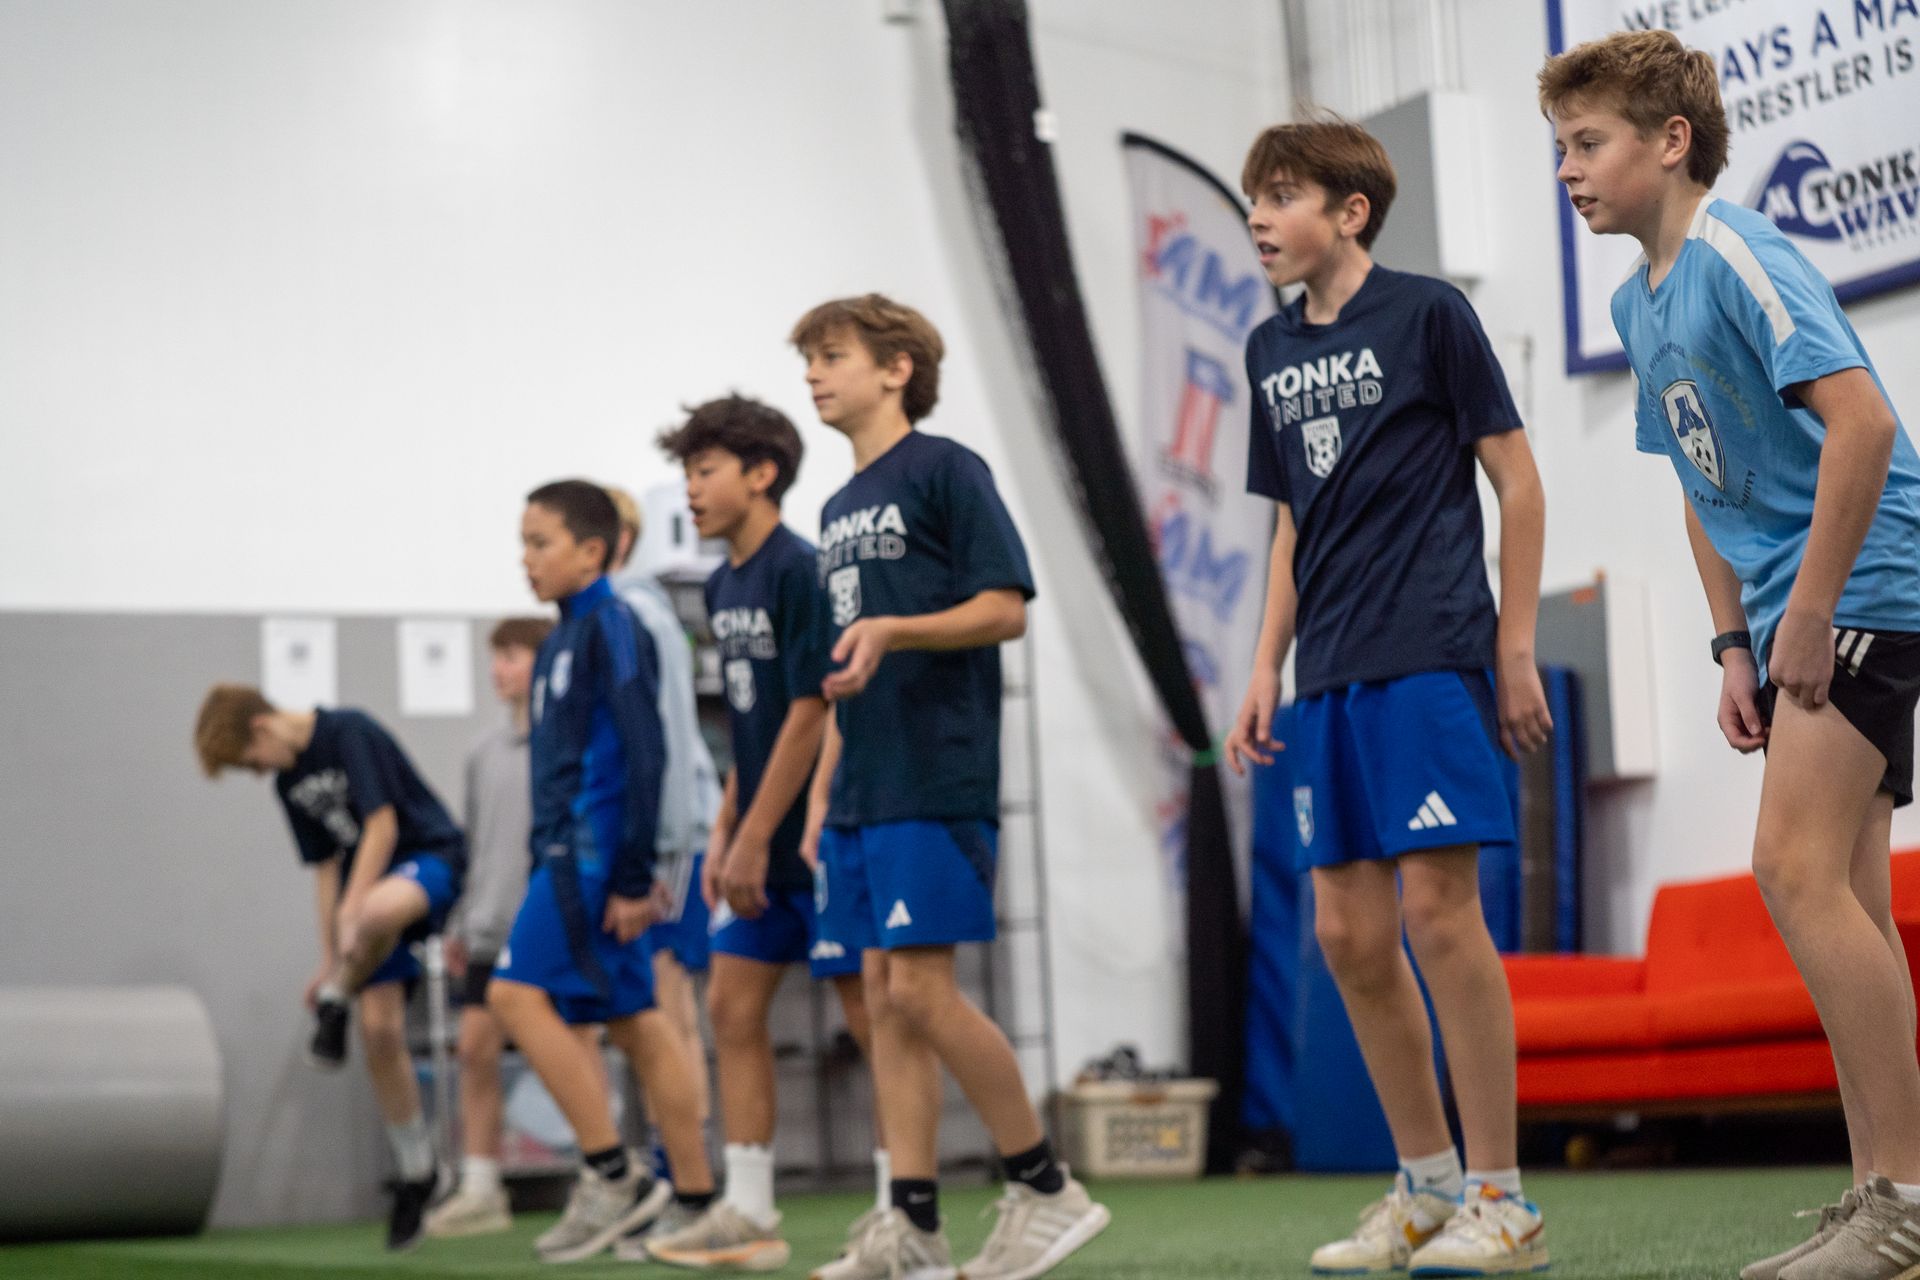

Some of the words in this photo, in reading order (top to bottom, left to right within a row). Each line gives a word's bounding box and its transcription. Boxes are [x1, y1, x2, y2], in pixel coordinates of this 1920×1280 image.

[1721, 25, 1793, 91] AYS
[1810, 10, 1839, 57] A
[1854, 0, 1919, 40] MA
[1884, 37, 1914, 77] IS
[1810, 149, 1918, 212] TONK
[1840, 186, 1920, 236] WAV
[1261, 348, 1384, 407] TONKA
[821, 503, 908, 552] ONKA
